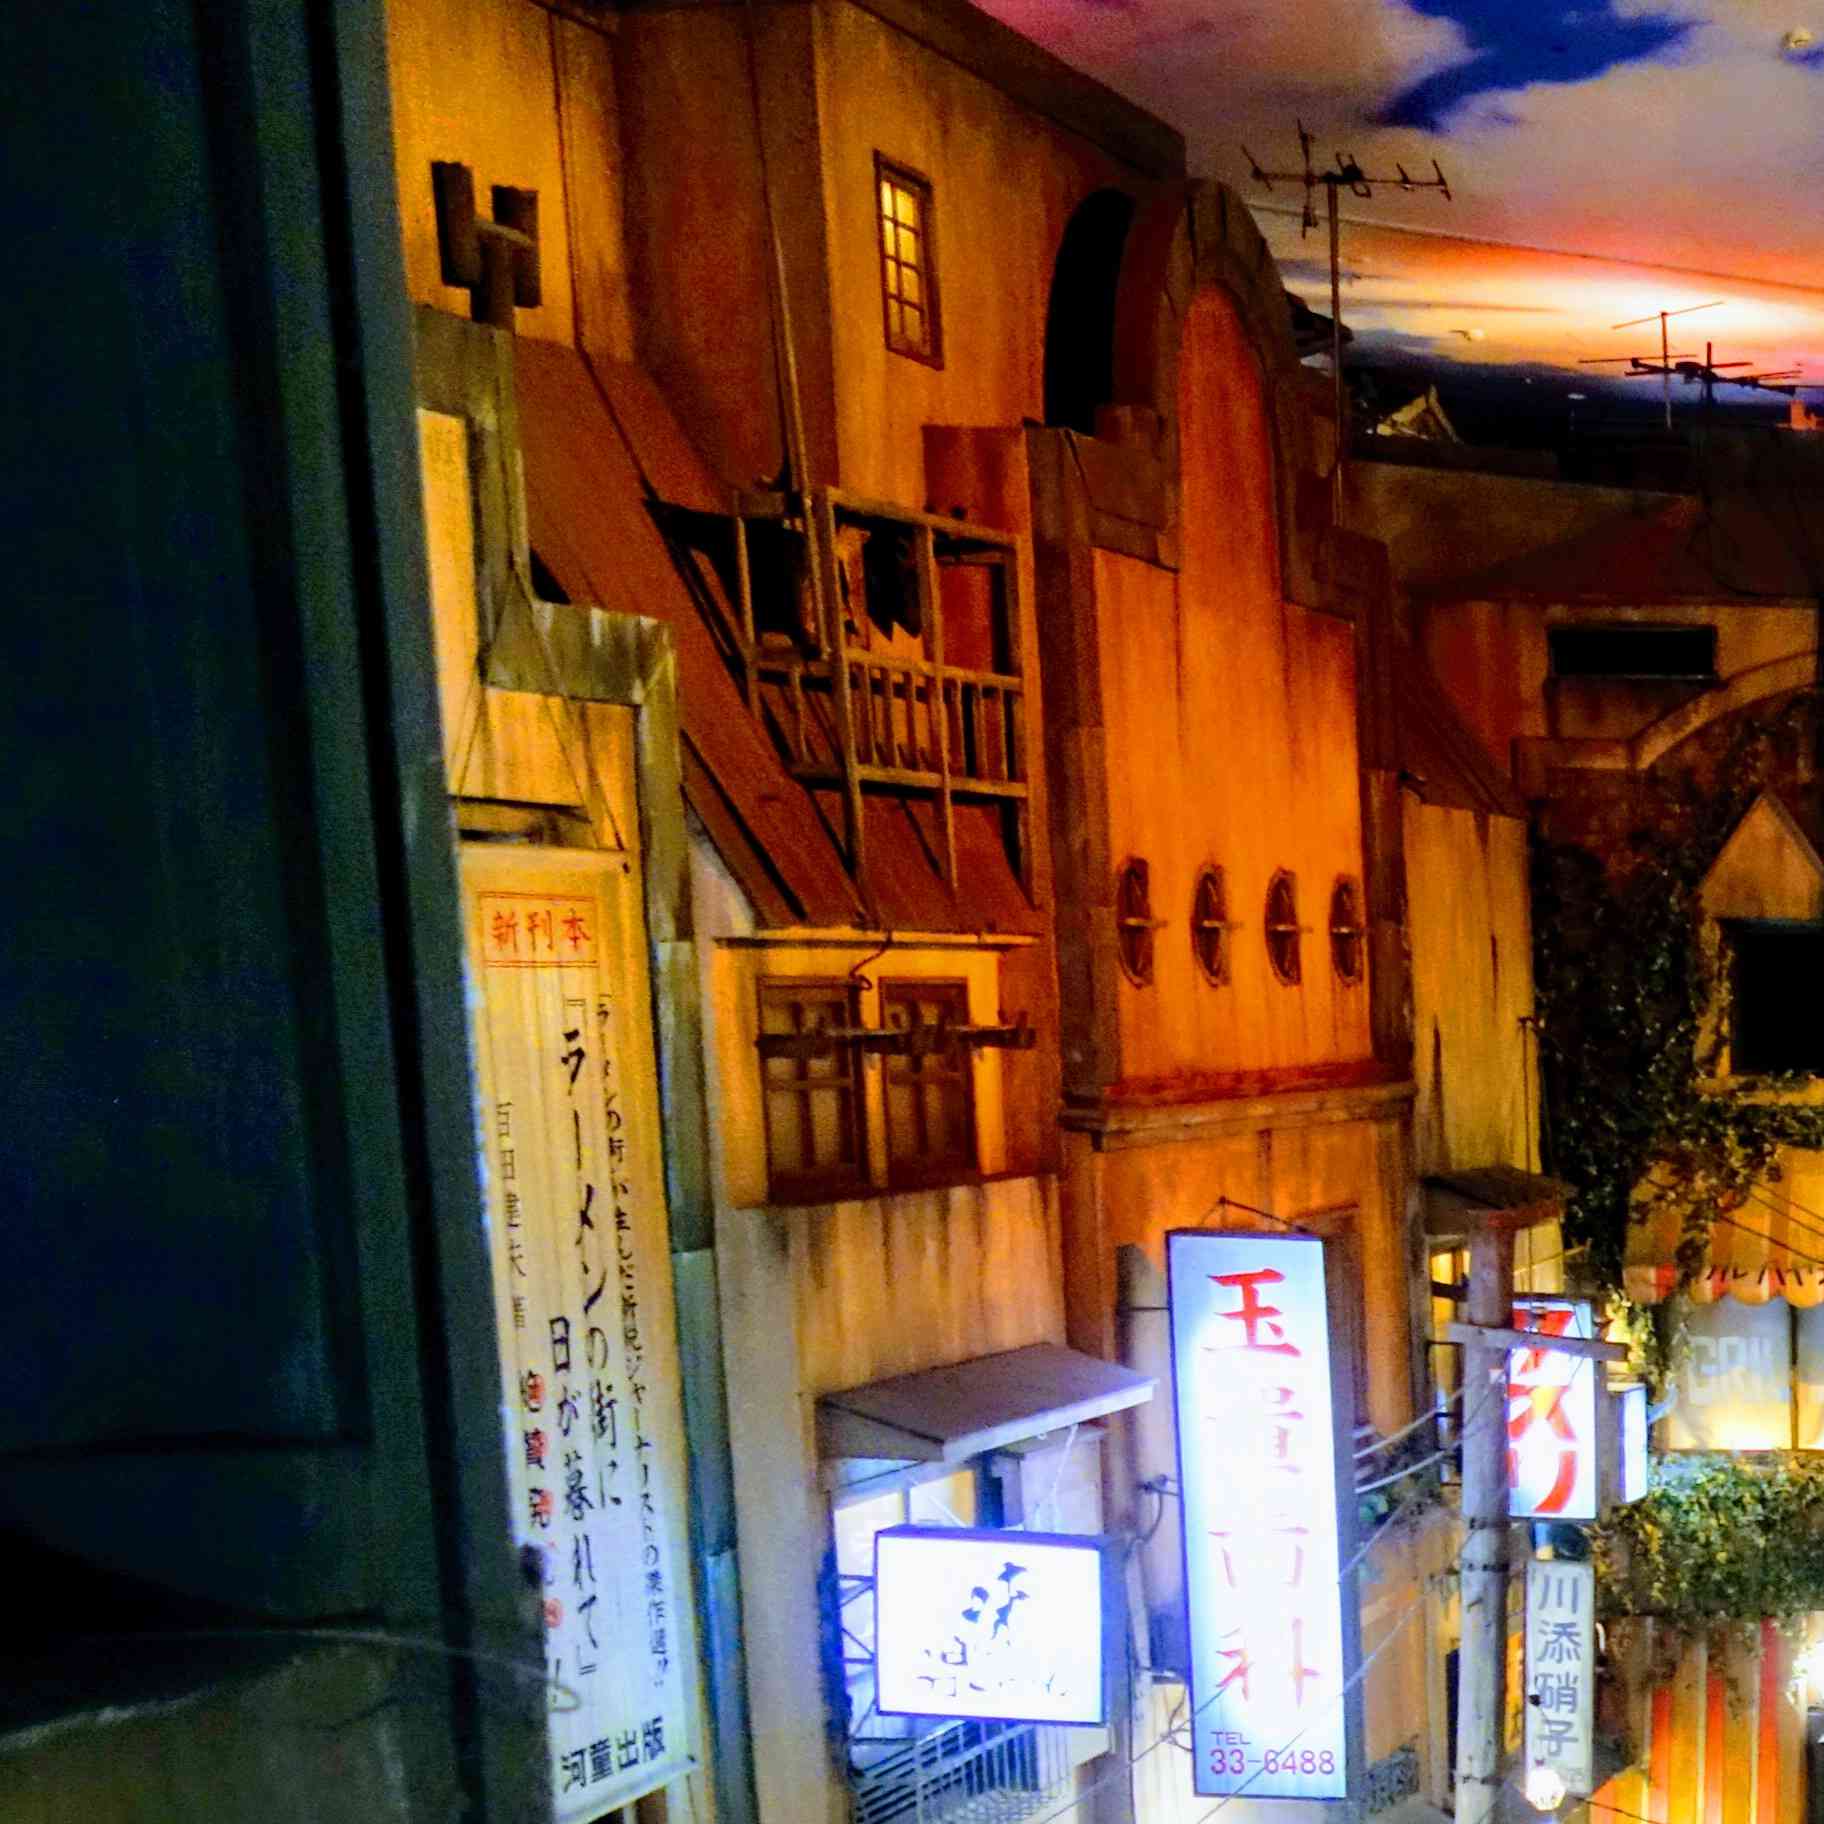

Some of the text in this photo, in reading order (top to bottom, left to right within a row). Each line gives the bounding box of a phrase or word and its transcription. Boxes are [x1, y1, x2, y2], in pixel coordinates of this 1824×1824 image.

[493, 909, 589, 952] 新刊本
[1211, 1730, 1253, 1747] TEL
[1209, 1749, 1337, 1778] 33-6488
